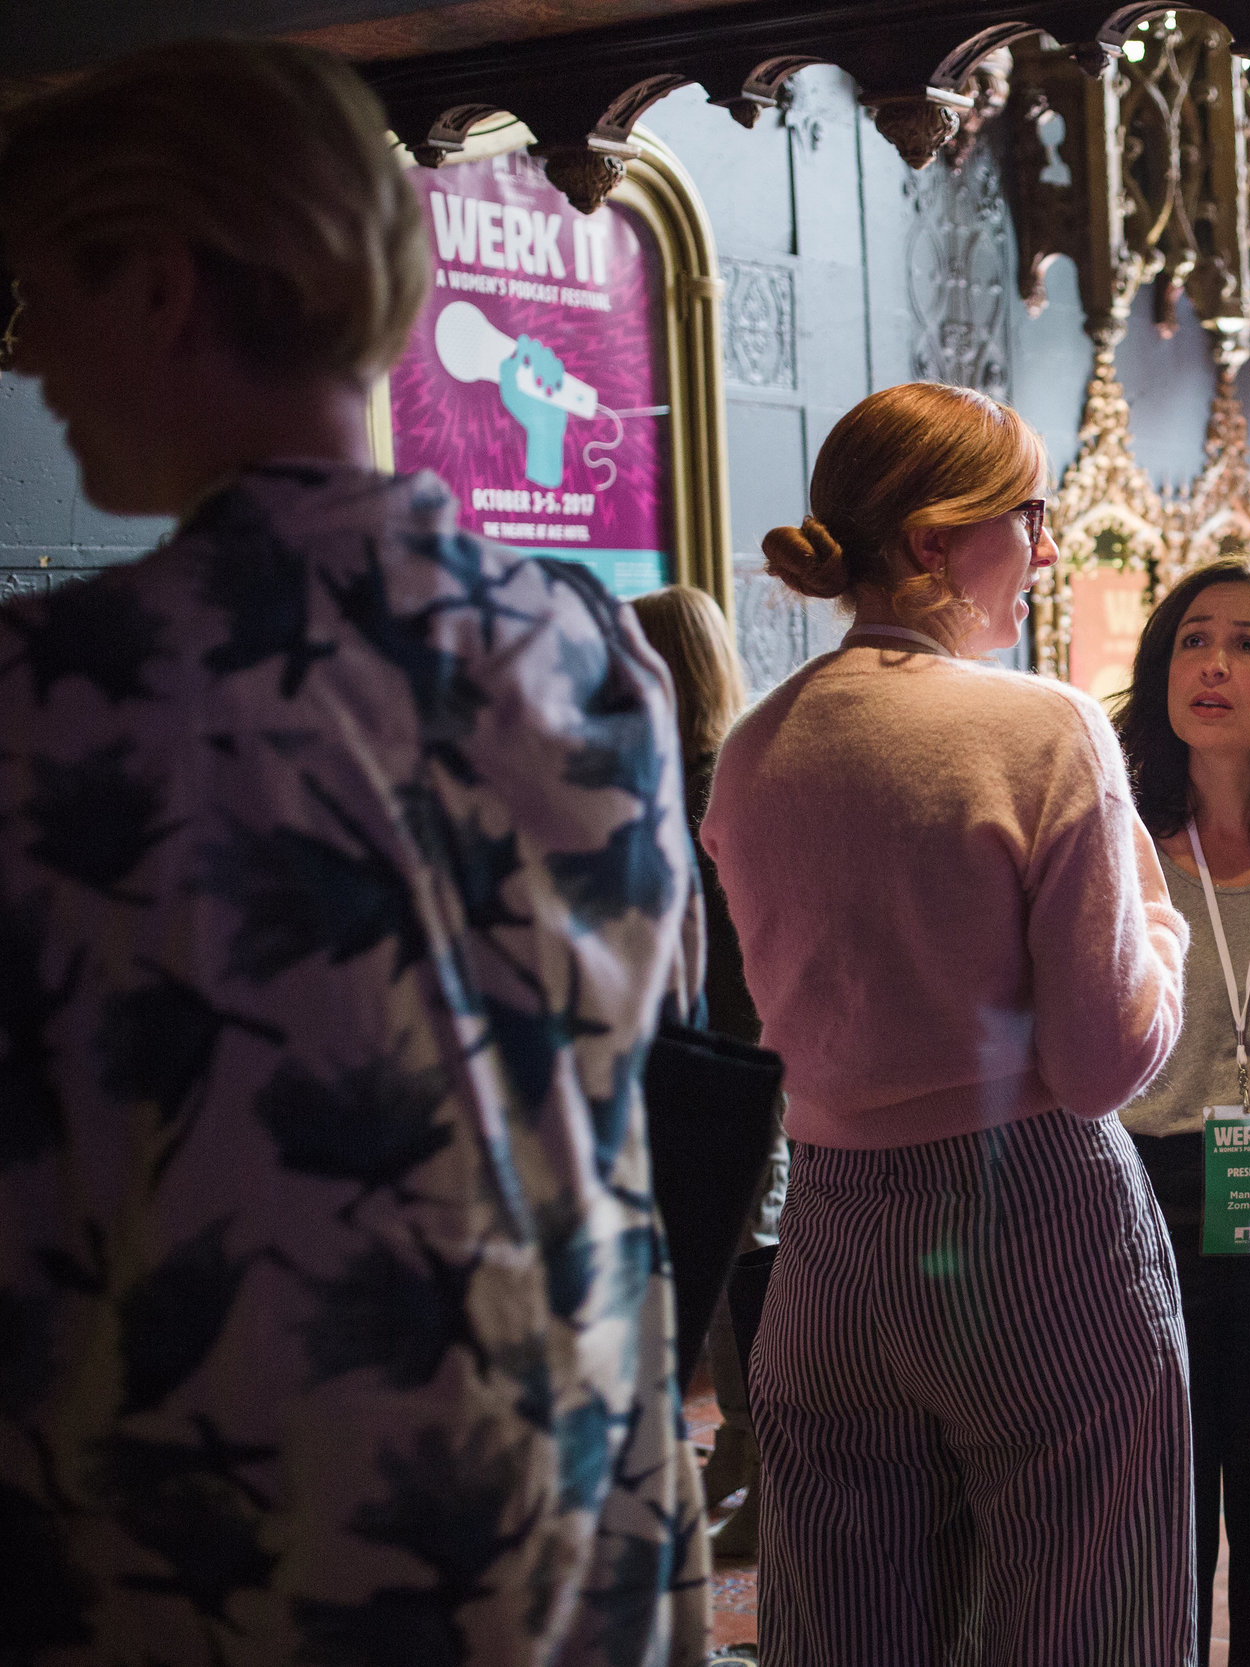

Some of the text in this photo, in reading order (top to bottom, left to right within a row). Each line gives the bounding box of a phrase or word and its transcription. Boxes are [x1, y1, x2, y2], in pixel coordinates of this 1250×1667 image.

[430, 191, 607, 286] WERK IT
[435, 268, 612, 312] A WOMEN'S PODCAST FESTIVAL
[472, 488, 530, 513] OCTOBER
[562, 493, 595, 516] 2017
